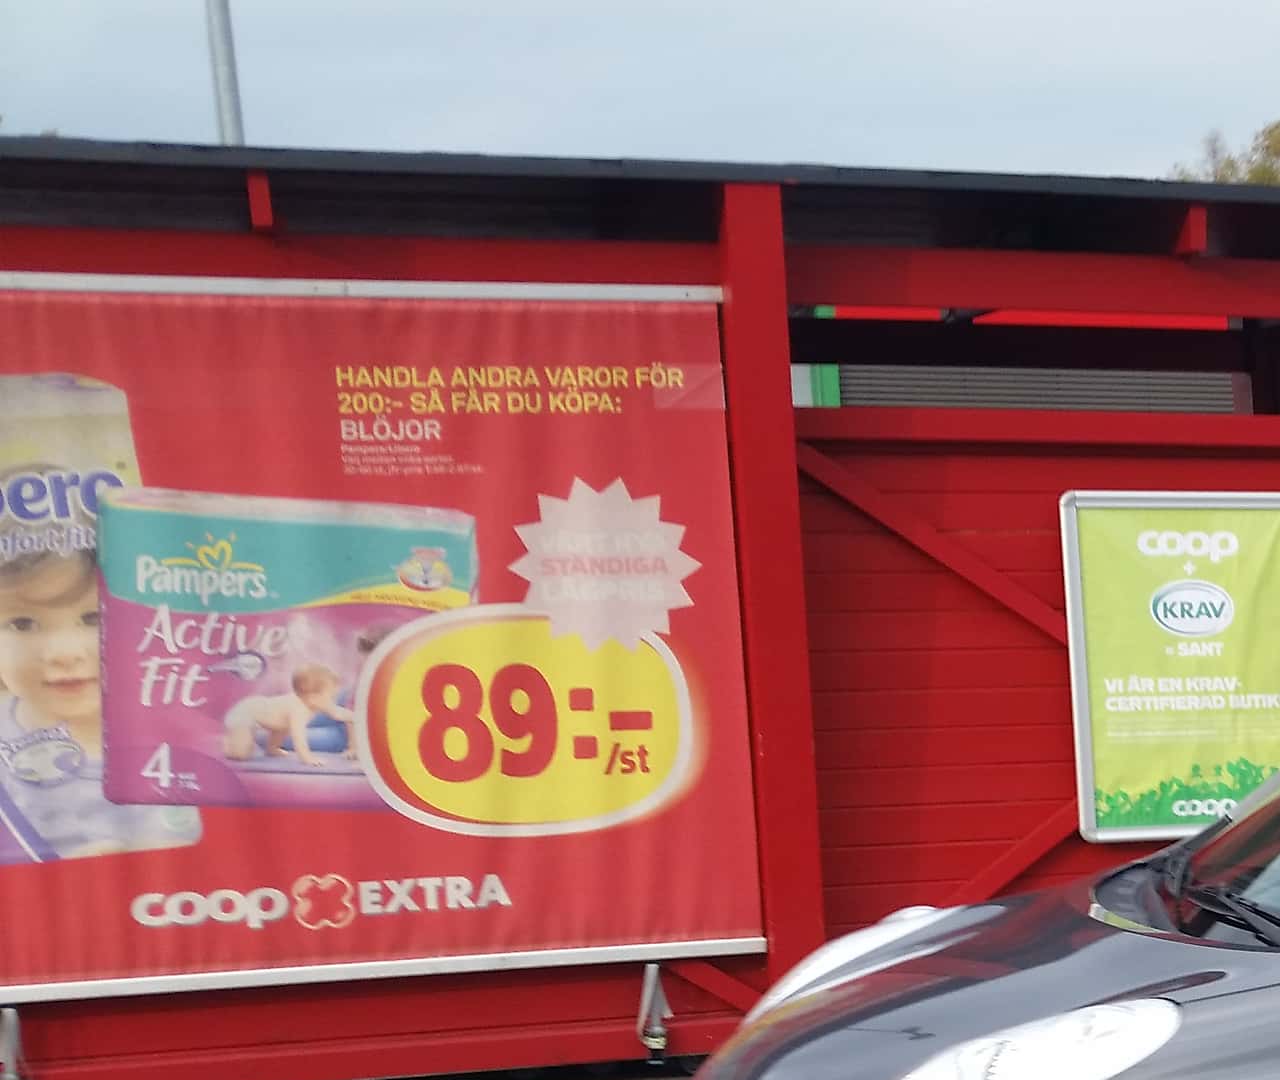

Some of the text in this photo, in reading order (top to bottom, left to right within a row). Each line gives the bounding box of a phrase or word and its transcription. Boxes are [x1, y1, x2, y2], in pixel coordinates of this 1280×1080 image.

[336, 363, 684, 389] HANDLA ANDRA VAROR FÖR
[338, 388, 622, 414] 200:- SÅ FÅR DU KÖPA:
[341, 416, 441, 440] BLÖJOR
[0, 471, 124, 520] ero
[1137, 531, 1239, 564] coop
[136, 555, 267, 605] Pampers
[541, 554, 668, 576] STÄNDIGA
[1163, 600, 1226, 620] KRAV
[137, 603, 289, 657] Active
[1177, 642, 1223, 657] SANT
[139, 657, 209, 707] Fit
[1104, 674, 1241, 693] VI ÄR EN KRAV-
[1105, 695, 1225, 712] CERTIFIERAD
[418, 663, 653, 783] 89:-
[141, 742, 171, 788] 4
[604, 743, 651, 776] /st
[130, 873, 512, 929] coop EXTRA
